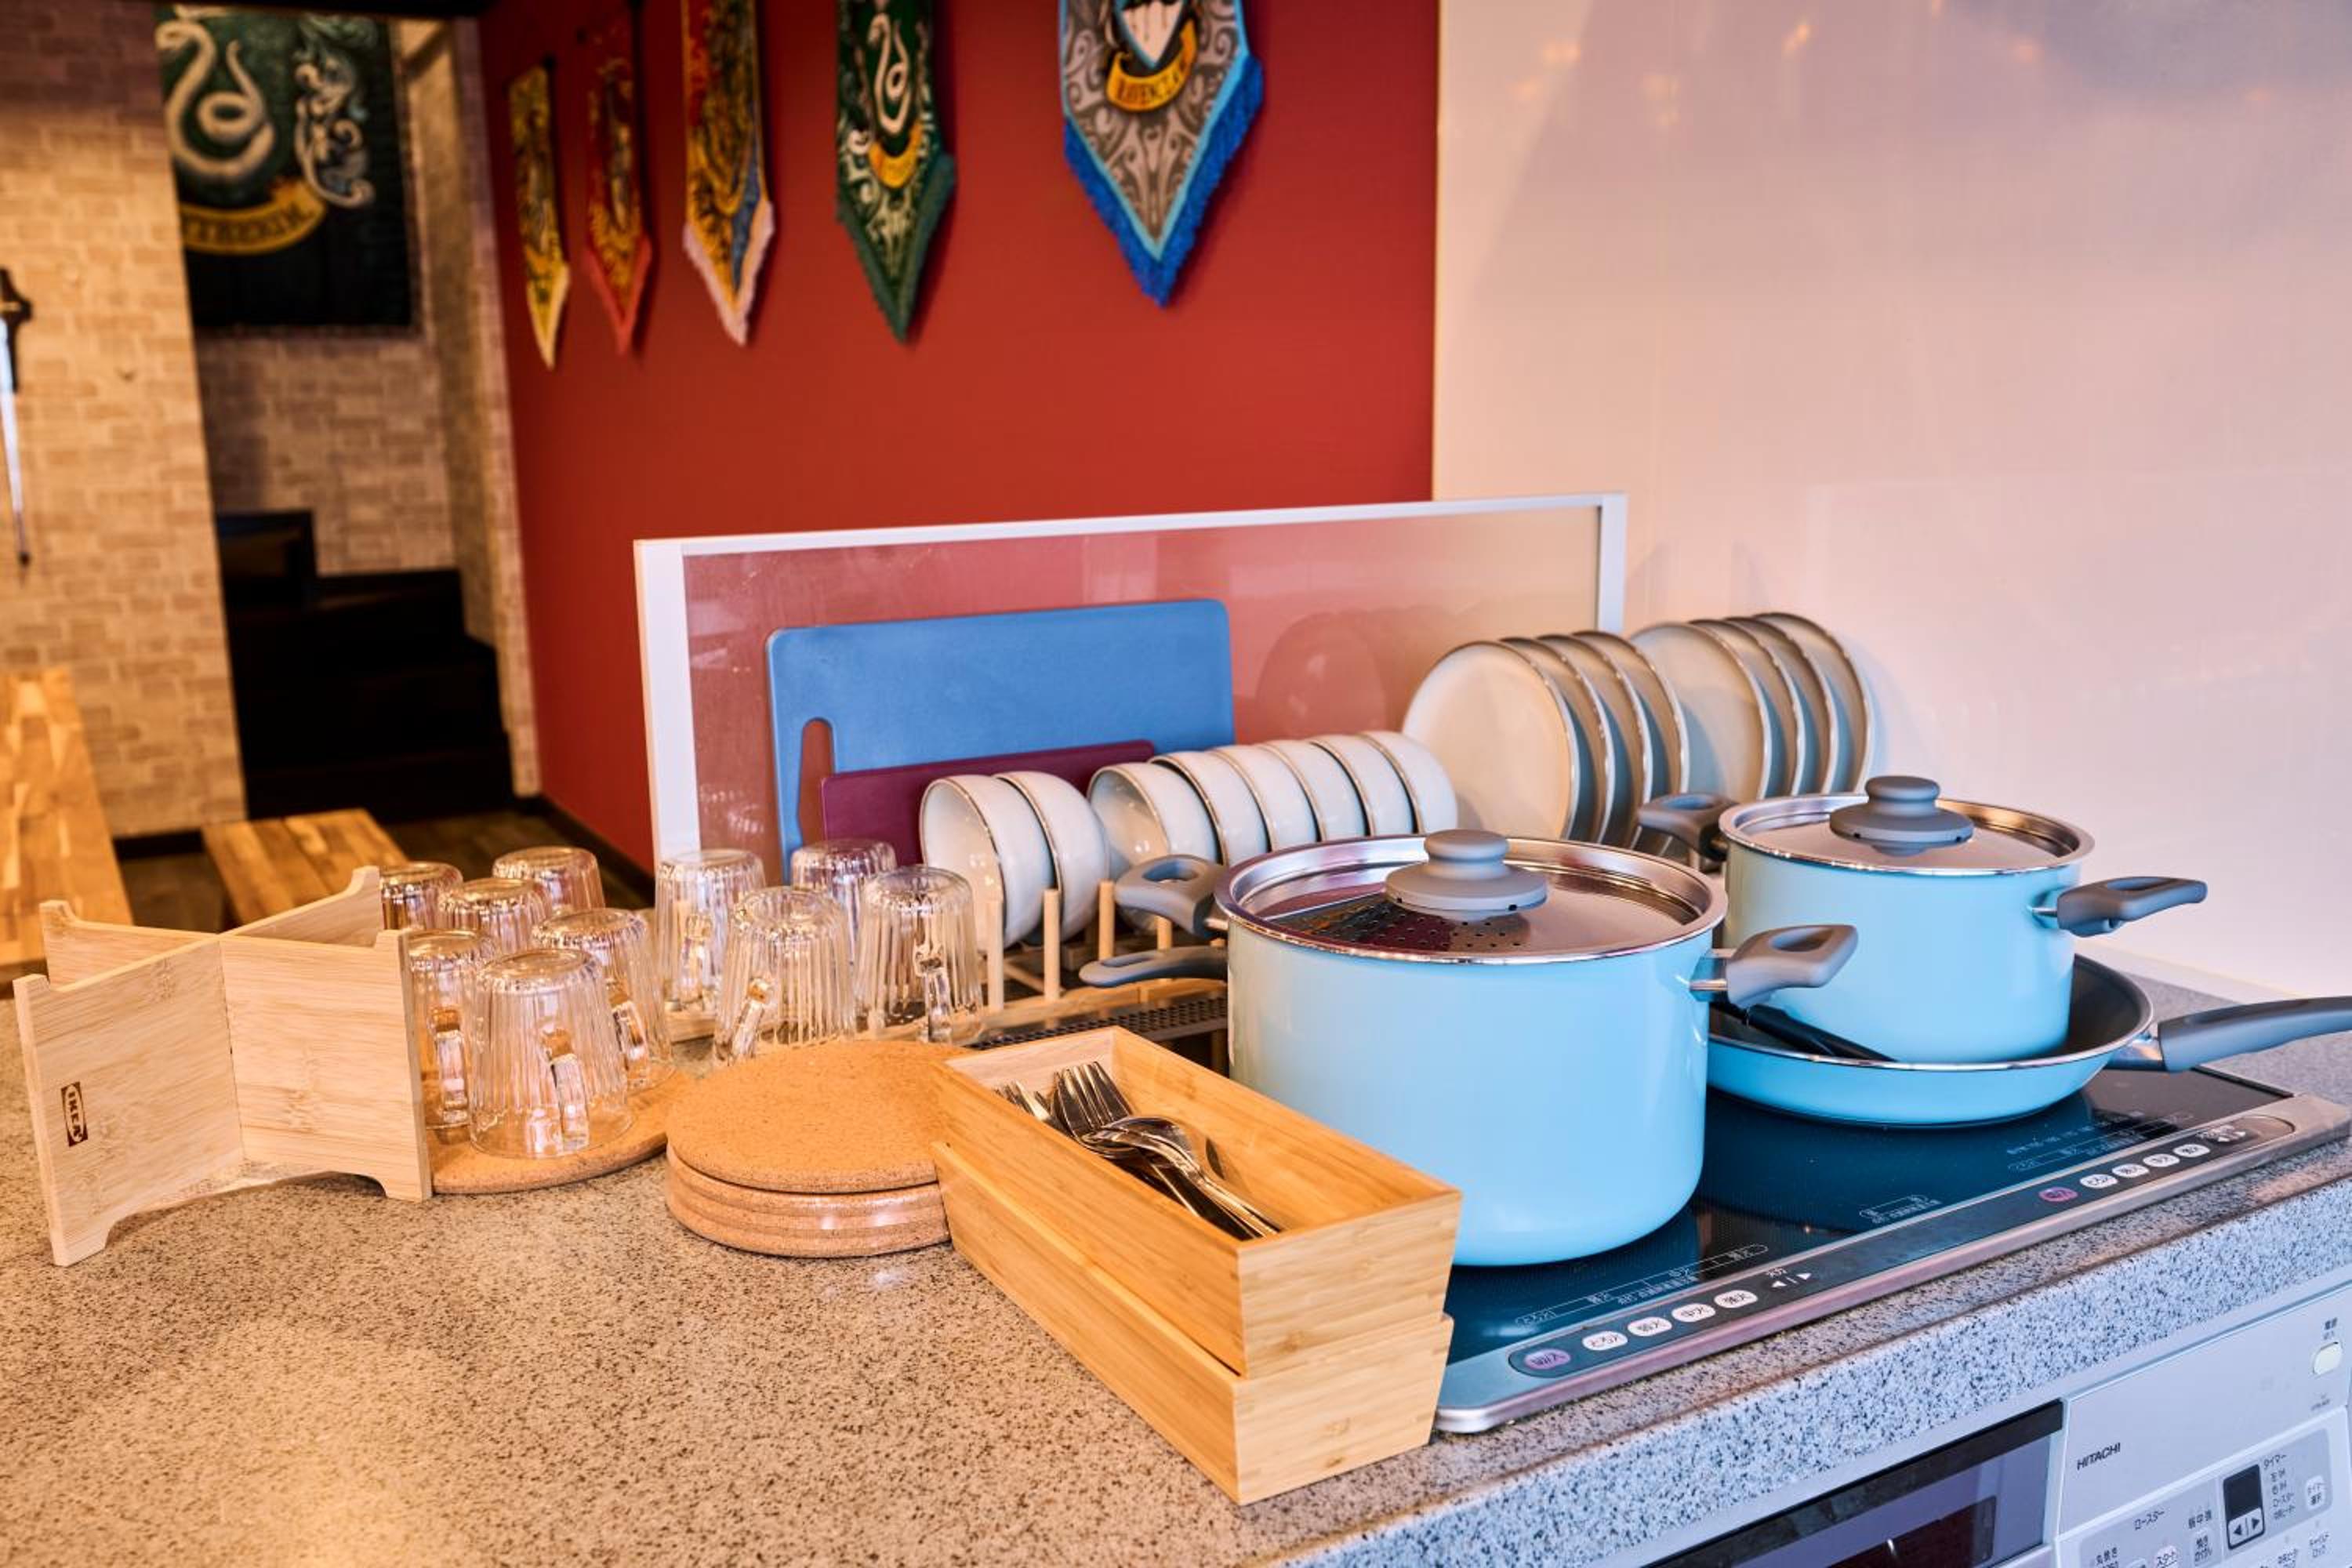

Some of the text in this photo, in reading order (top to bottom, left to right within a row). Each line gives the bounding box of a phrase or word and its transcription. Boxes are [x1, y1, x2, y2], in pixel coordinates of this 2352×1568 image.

[67, 1091, 82, 1138] IKEA
[2077, 1442, 2121, 1471] HITACHI
[2134, 1511, 2165, 1530] ロースター
